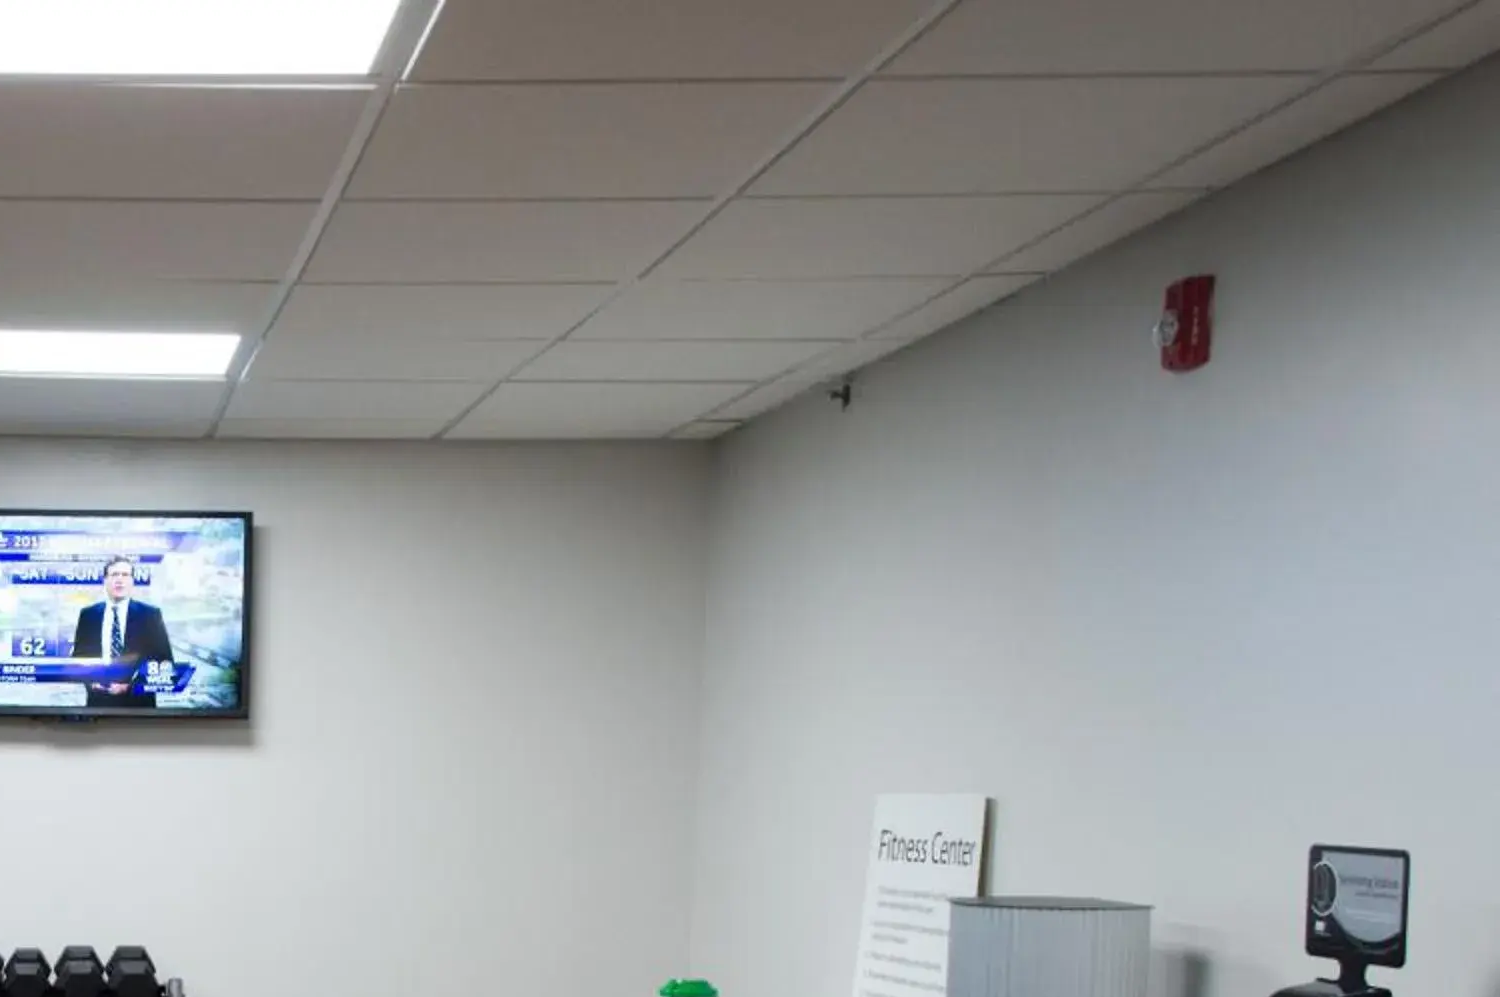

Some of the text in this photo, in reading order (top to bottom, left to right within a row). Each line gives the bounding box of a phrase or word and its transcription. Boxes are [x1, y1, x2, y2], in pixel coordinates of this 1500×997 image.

[21, 637, 46, 655] 62
[877, 828, 976, 867] Fitness Center
